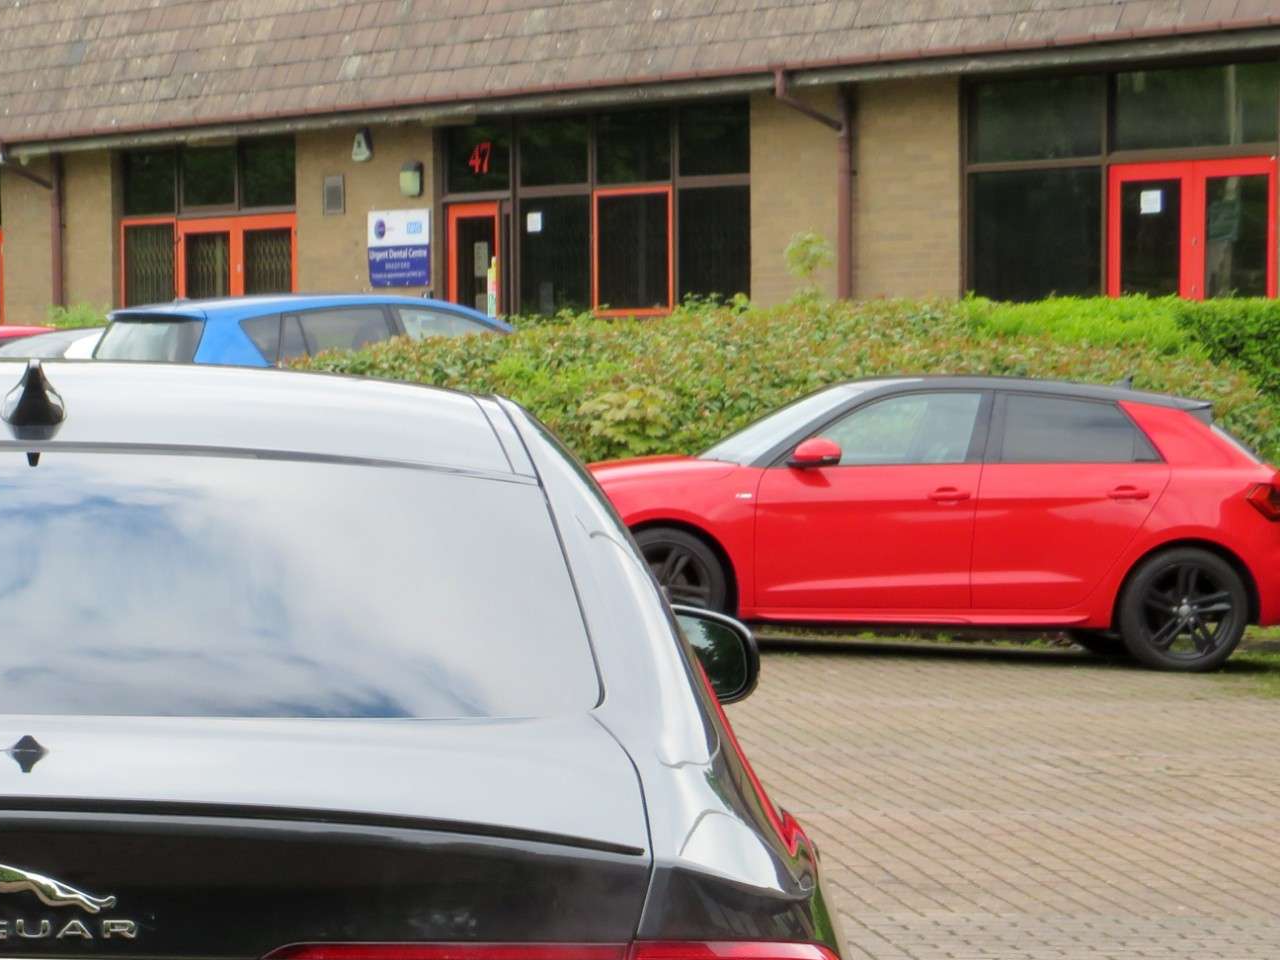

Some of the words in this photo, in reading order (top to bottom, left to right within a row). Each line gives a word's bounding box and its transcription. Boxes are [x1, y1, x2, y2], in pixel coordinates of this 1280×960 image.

[469, 142, 491, 175] 47
[369, 250, 388, 262] Urgent
[389, 248, 408, 259] Dental
[409, 247, 427, 258] Centre
